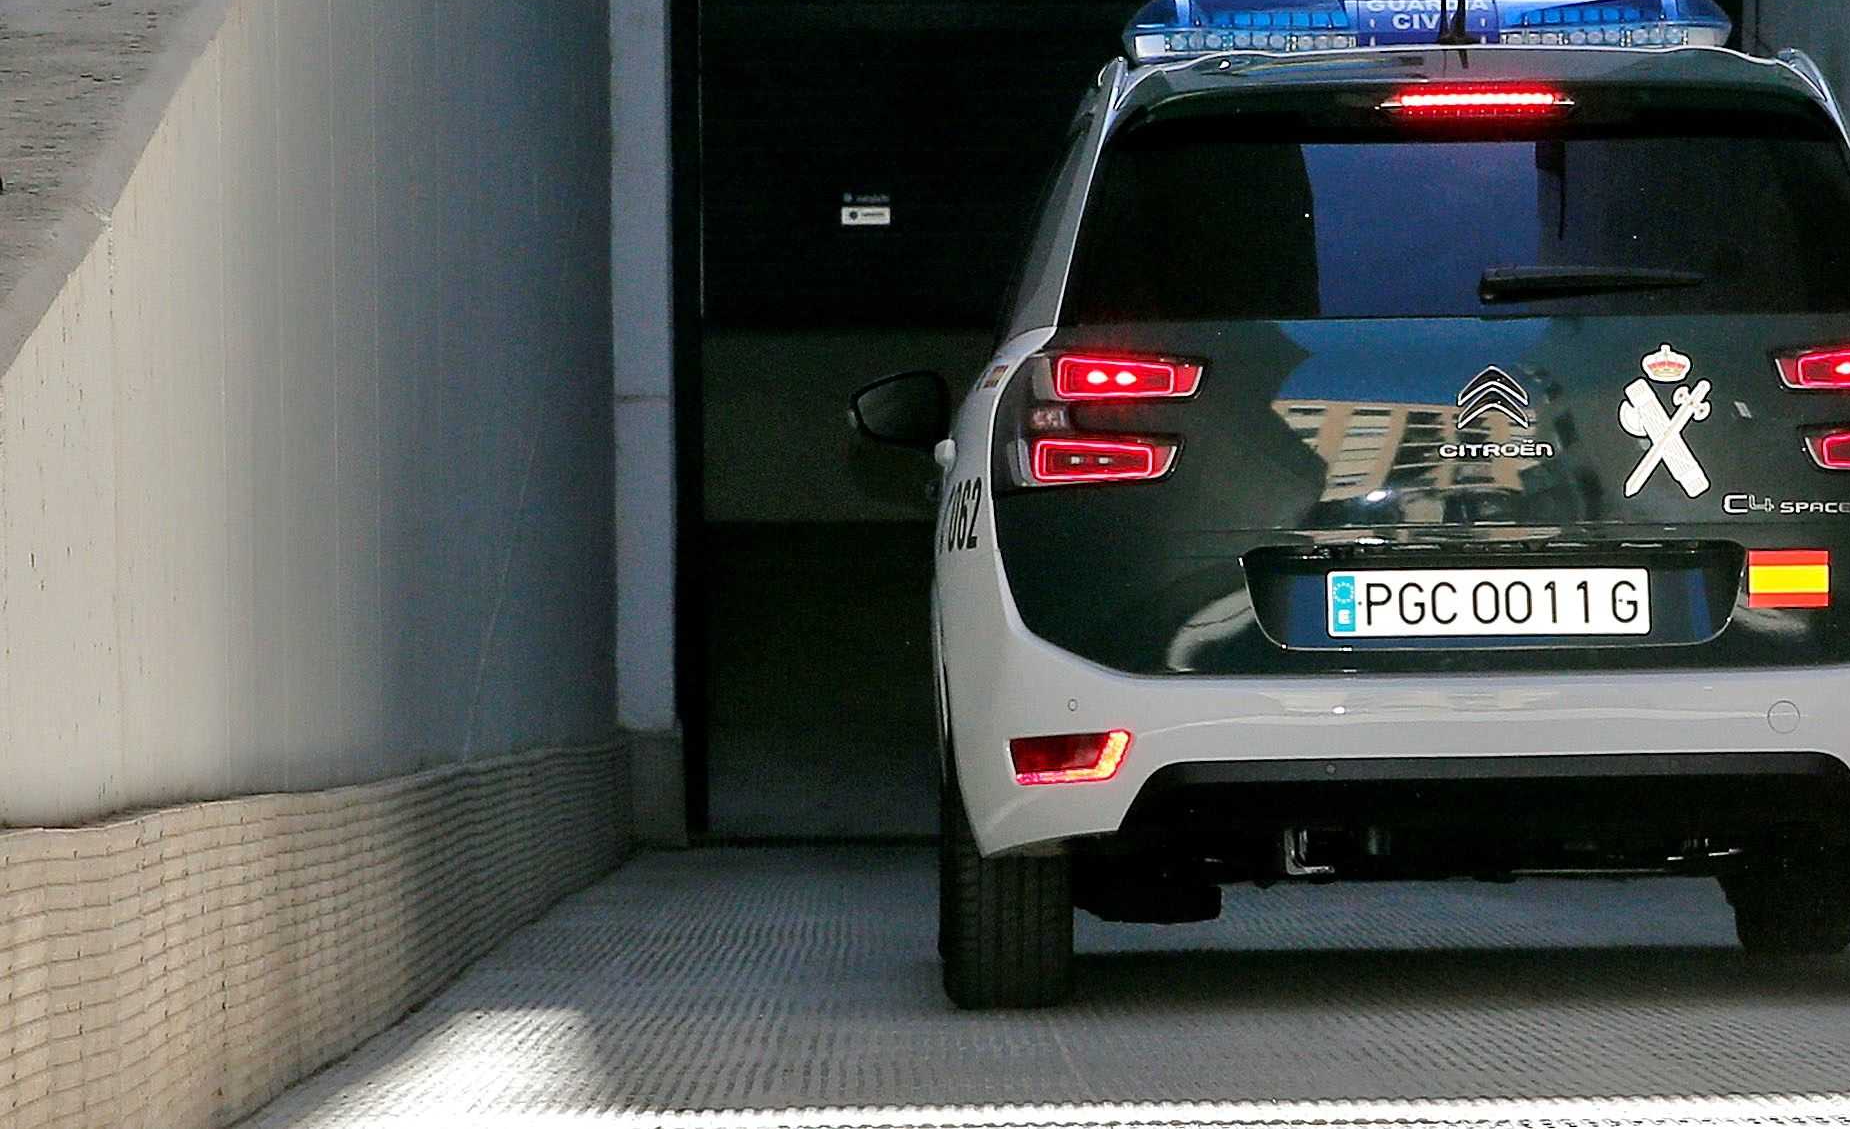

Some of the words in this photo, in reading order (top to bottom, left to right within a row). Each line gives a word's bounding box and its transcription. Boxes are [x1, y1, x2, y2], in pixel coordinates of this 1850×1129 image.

[1392, 13, 1463, 30] CIV
[1723, 494, 1775, 513] C4
[1338, 609, 1351, 625] E
[1366, 581, 1459, 626] PGC
[1472, 581, 1591, 624] 0011
[1610, 580, 1639, 623] G
